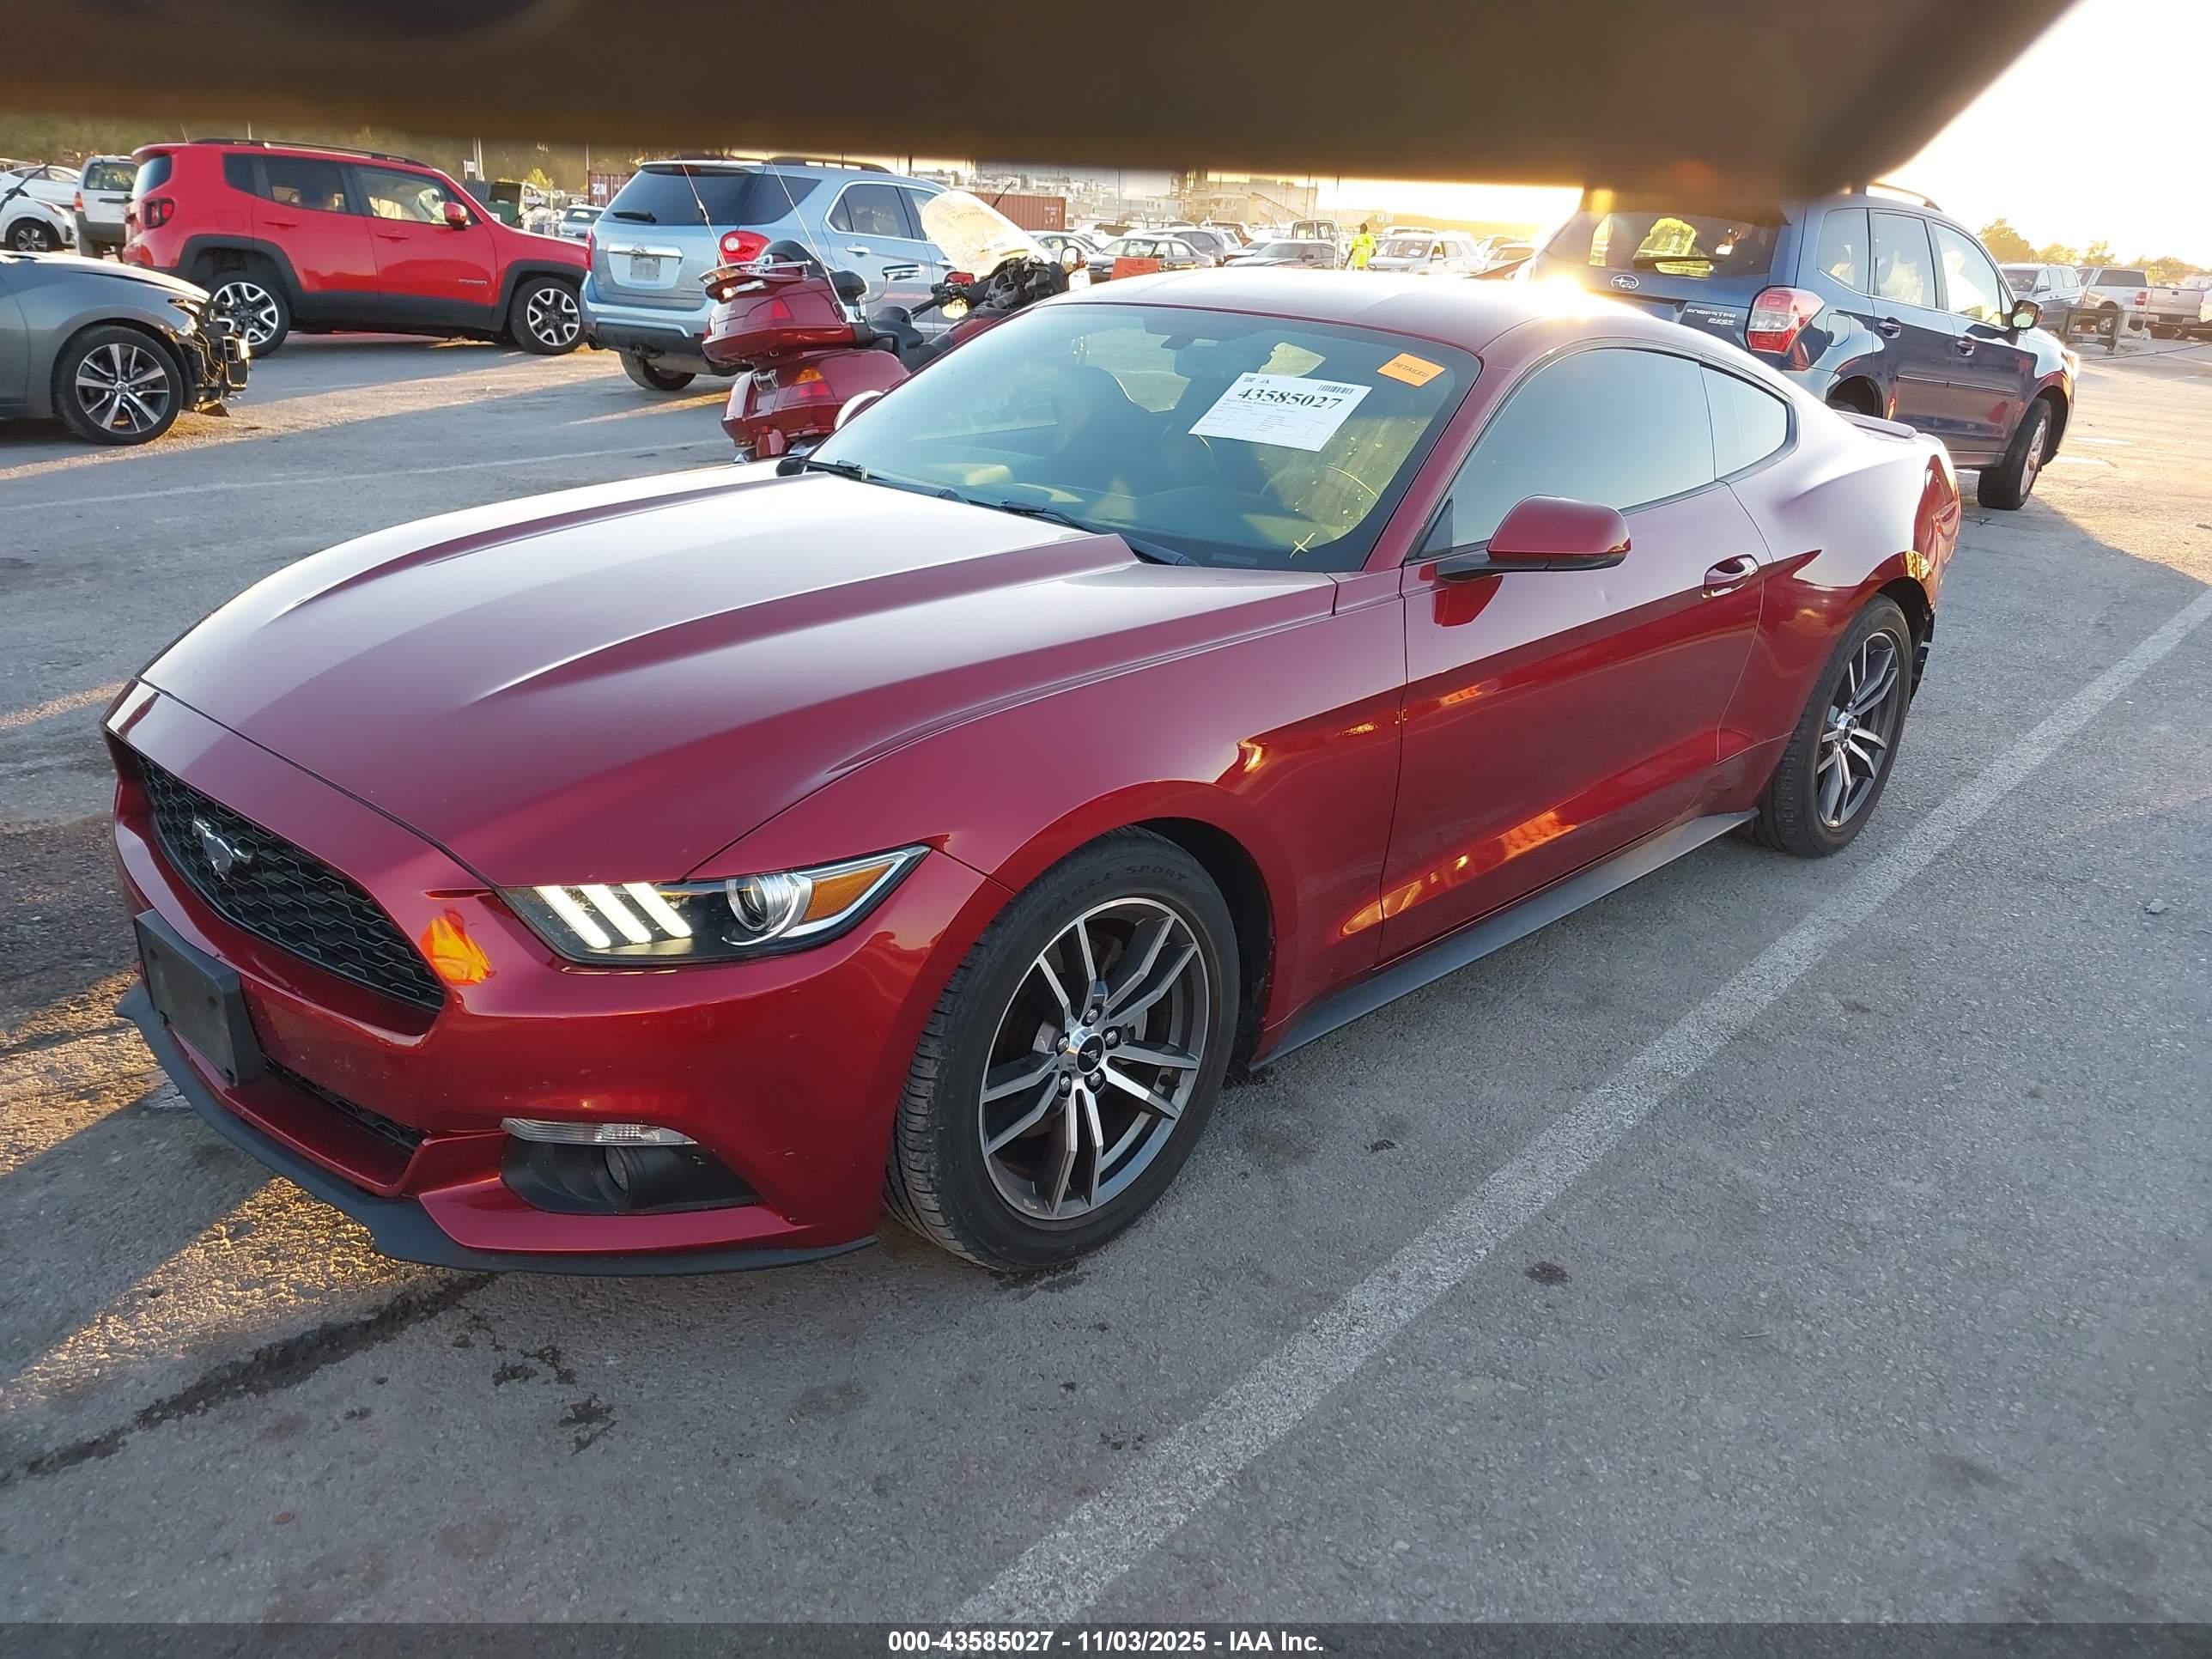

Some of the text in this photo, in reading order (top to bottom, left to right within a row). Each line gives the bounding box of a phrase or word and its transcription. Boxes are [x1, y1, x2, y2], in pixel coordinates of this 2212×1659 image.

[1686, 308, 1737, 318] FORESTER
[1392, 362, 1431, 378] DETAILED
[1237, 387, 1344, 410] 43585027
[1124, 865, 1188, 881] SPORT
